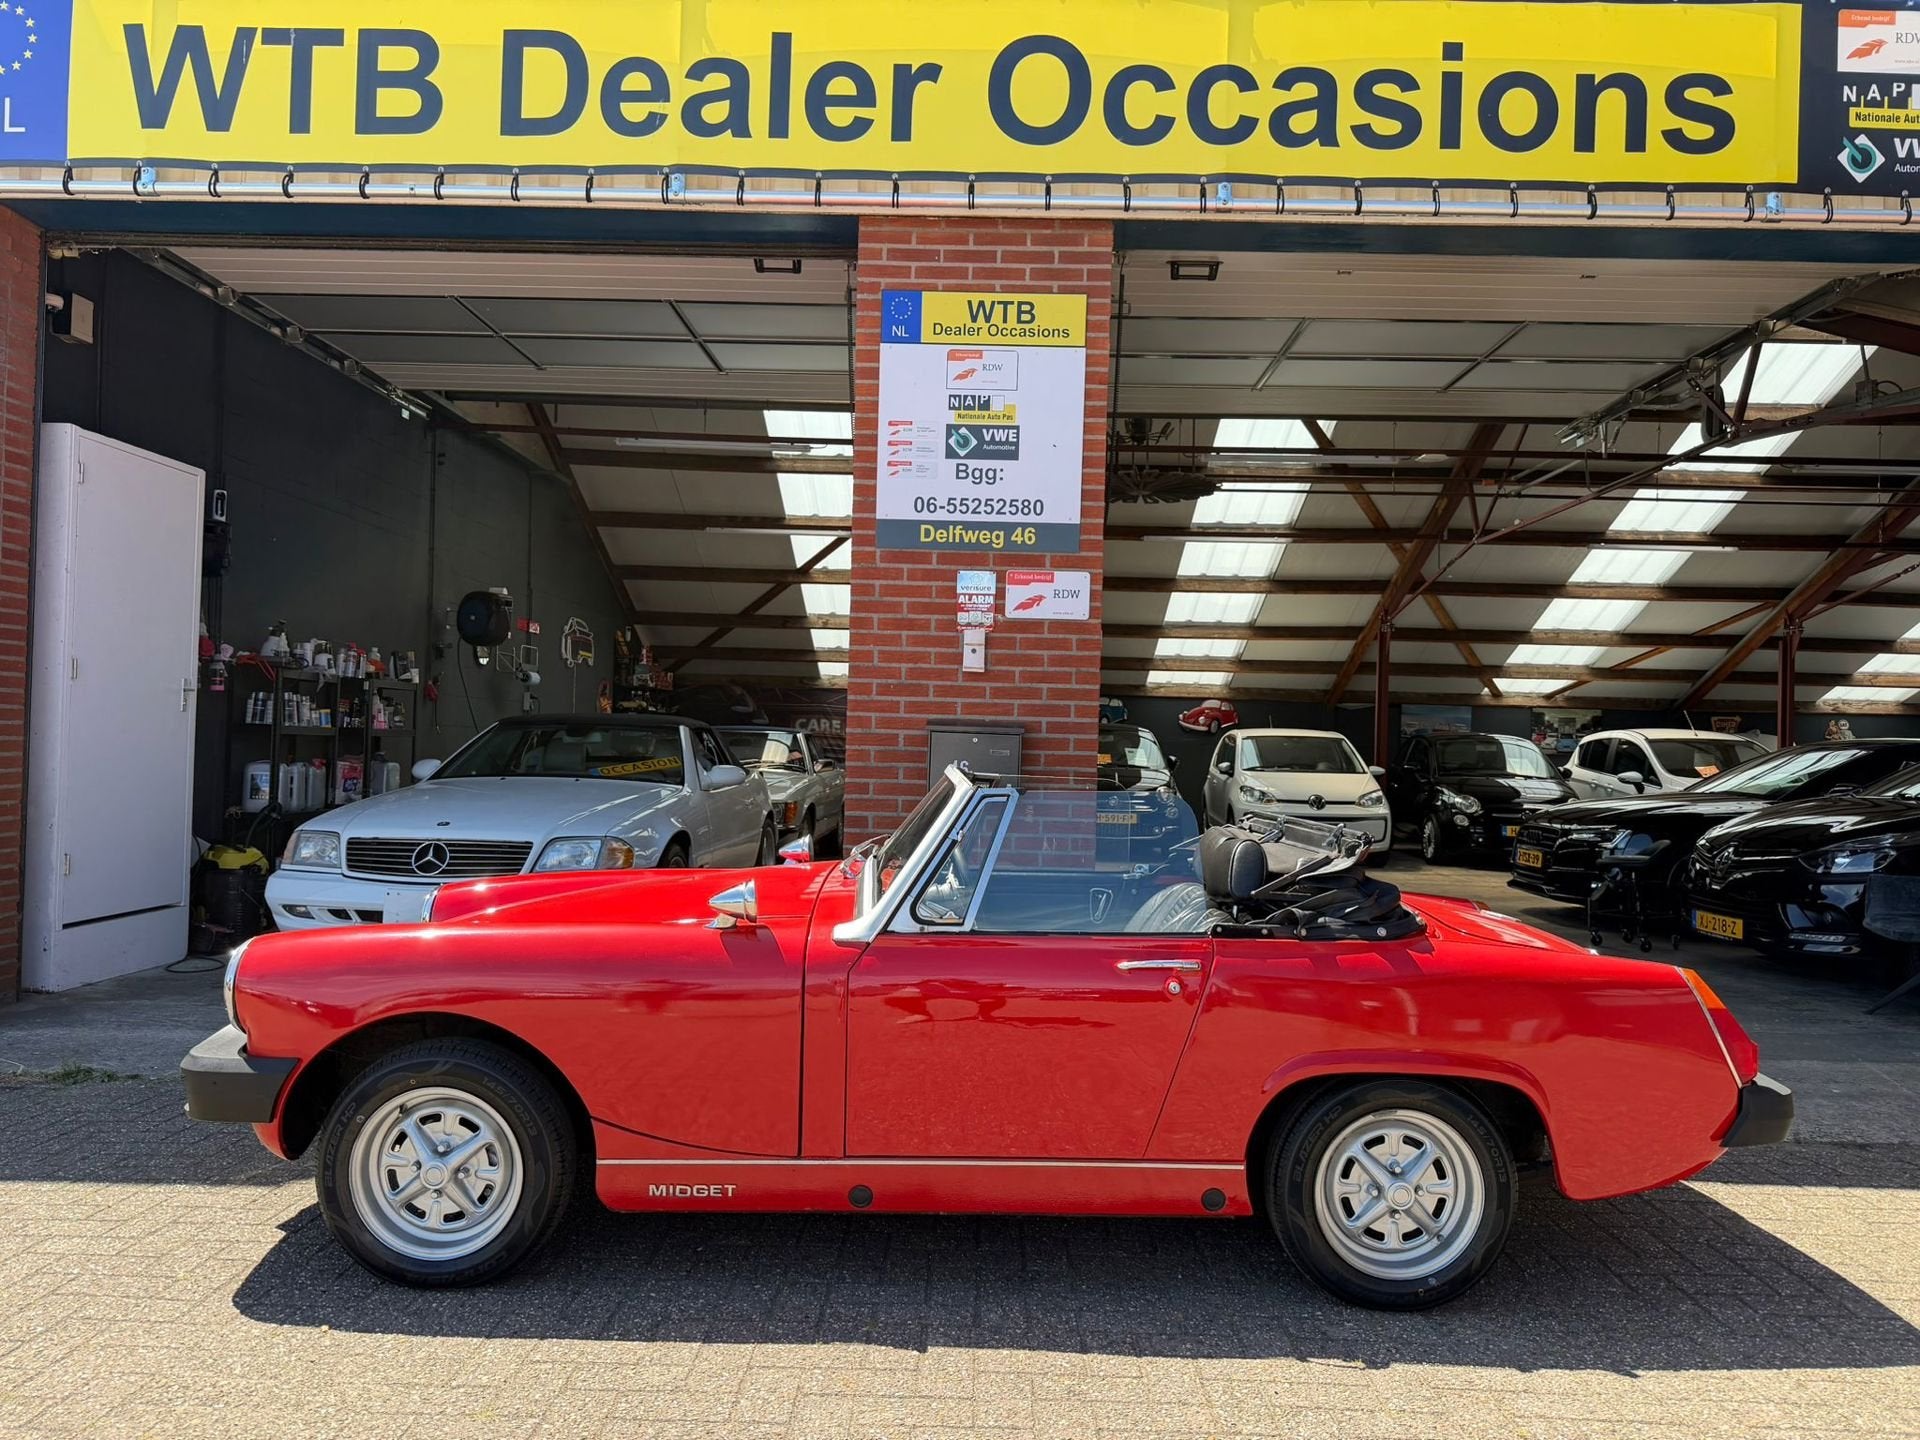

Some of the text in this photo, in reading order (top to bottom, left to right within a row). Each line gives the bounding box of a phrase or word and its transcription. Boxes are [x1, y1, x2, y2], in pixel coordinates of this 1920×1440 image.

[122, 23, 1736, 155] WTB Dealer Occasions
[1855, 111, 1901, 123] Nationale
[967, 300, 1036, 325] WTB
[891, 325, 909, 337] NL
[933, 323, 1070, 338] Dealer Occasions
[982, 363, 1003, 372] RDW
[982, 428, 1018, 442] VWE
[955, 463, 1004, 485] Bgg:
[914, 496, 1044, 517] 06-55252580
[920, 524, 1036, 548] Delfweg 46
[958, 595, 994, 604] ALARM
[1053, 588, 1080, 599] RDW
[795, 718, 841, 733] CARE
[600, 756, 680, 777] OCCASION
[1700, 914, 1737, 935] XJ-218-Z
[649, 1184, 737, 1197] MIDGET
